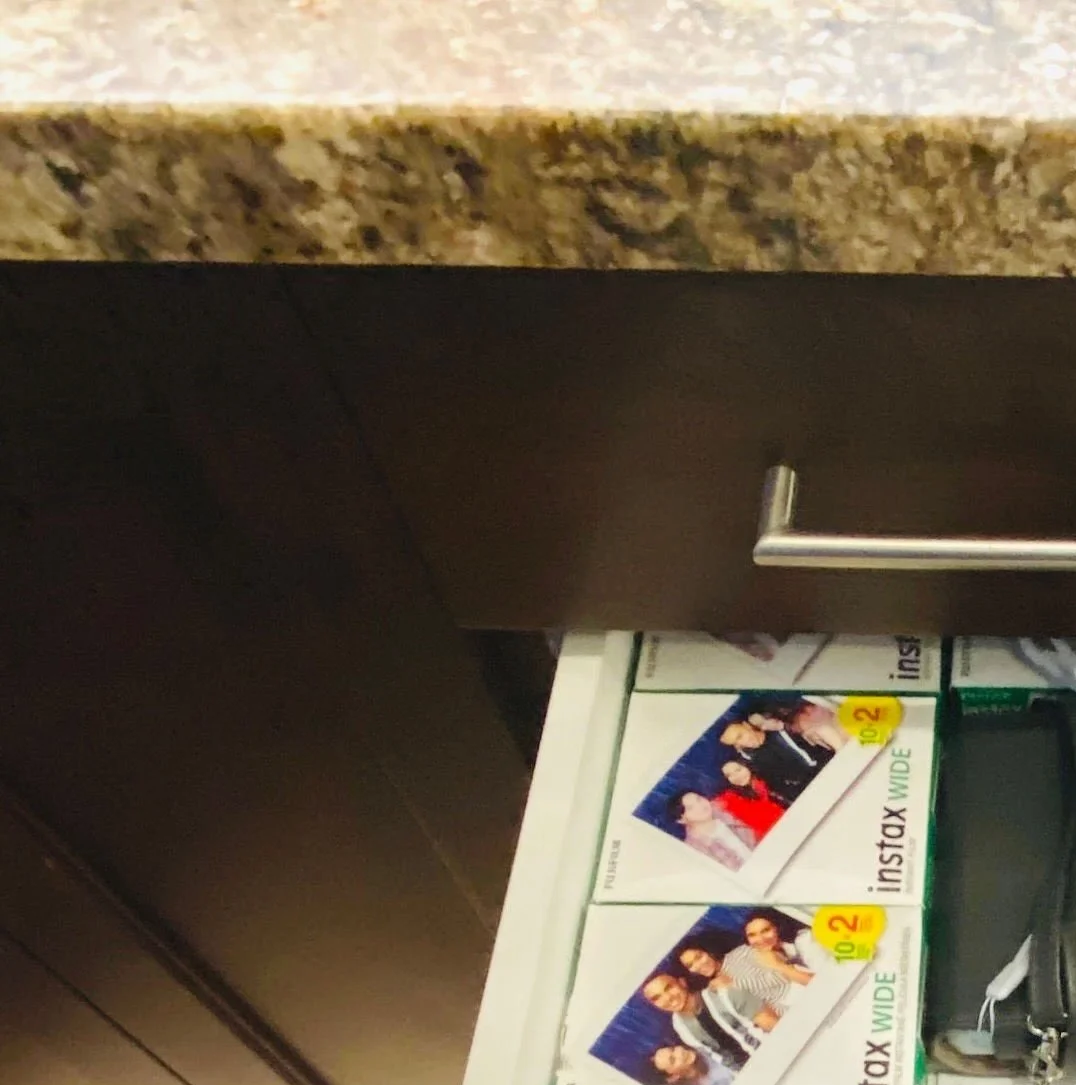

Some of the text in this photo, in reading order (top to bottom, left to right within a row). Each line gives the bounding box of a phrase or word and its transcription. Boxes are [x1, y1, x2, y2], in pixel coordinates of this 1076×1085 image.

[868, 806, 908, 893] instax
[888, 747, 912, 803] WIDE
[871, 971, 896, 1034] WIDE
